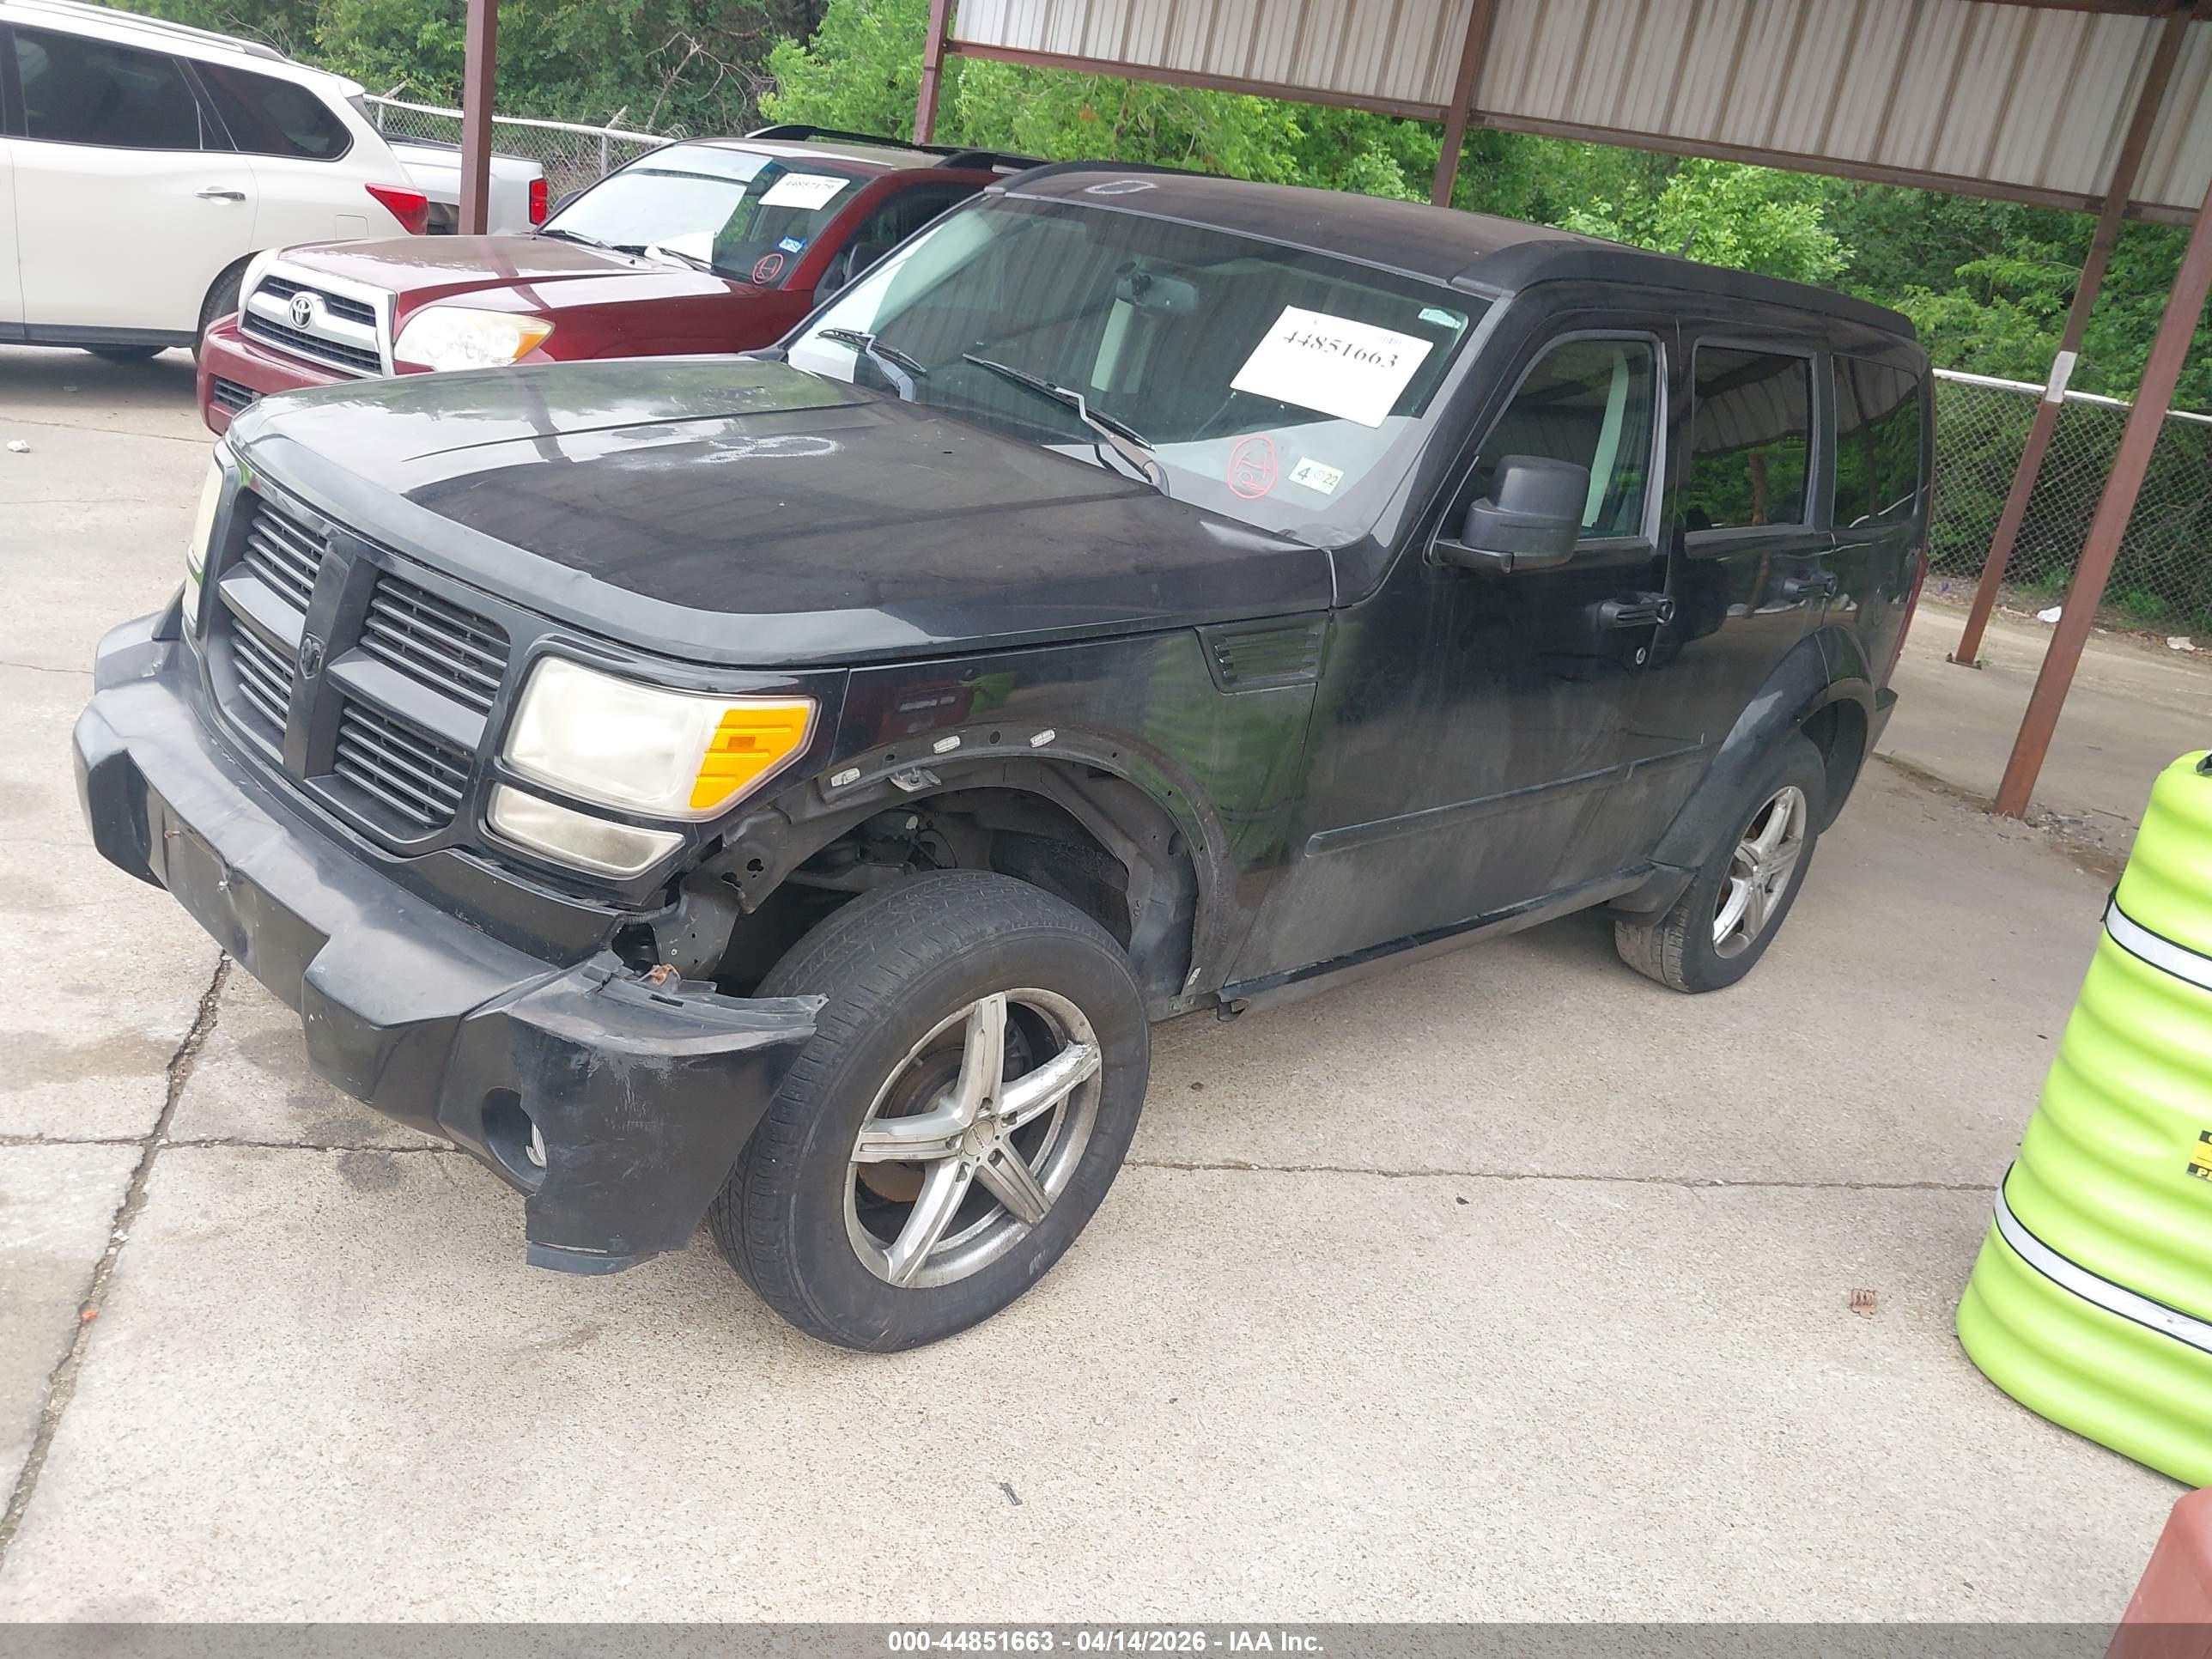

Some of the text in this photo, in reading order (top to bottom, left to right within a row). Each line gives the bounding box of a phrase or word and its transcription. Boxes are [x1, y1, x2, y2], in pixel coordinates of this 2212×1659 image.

[1284, 331, 1399, 368] 44851663
[1297, 466, 1339, 487] 4 22
